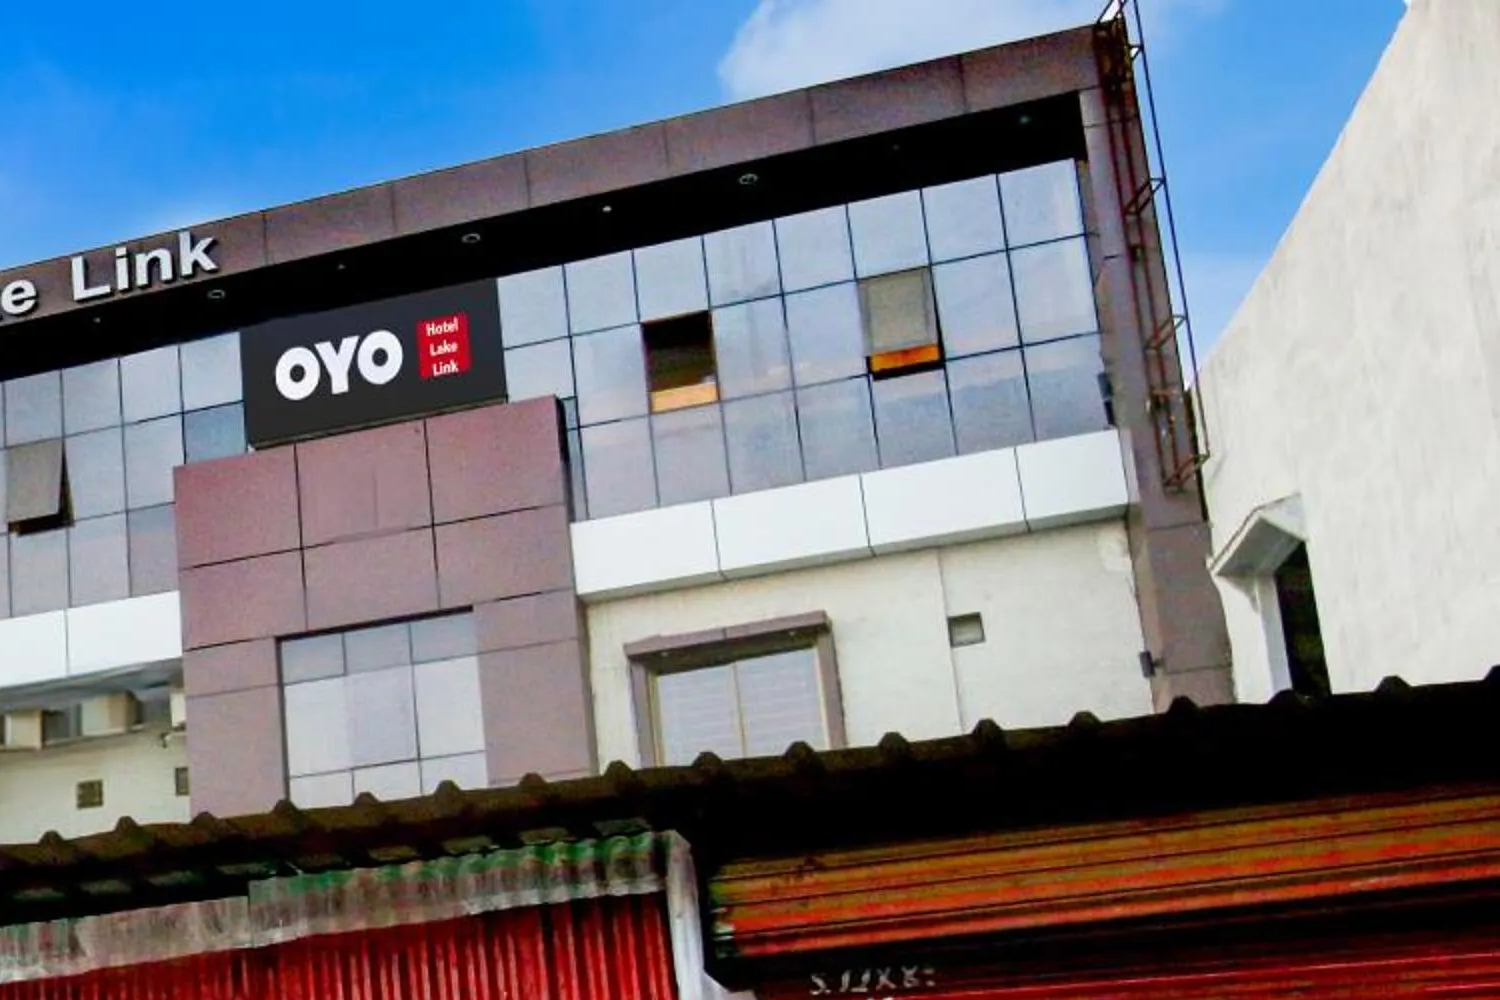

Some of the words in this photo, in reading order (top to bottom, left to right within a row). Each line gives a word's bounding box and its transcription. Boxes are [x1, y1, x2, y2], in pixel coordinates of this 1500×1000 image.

[71, 231, 219, 301] Link
[425, 316, 459, 337] Hotel
[429, 341, 459, 357] Lake
[275, 329, 403, 401] OYO
[432, 361, 460, 377] Link
